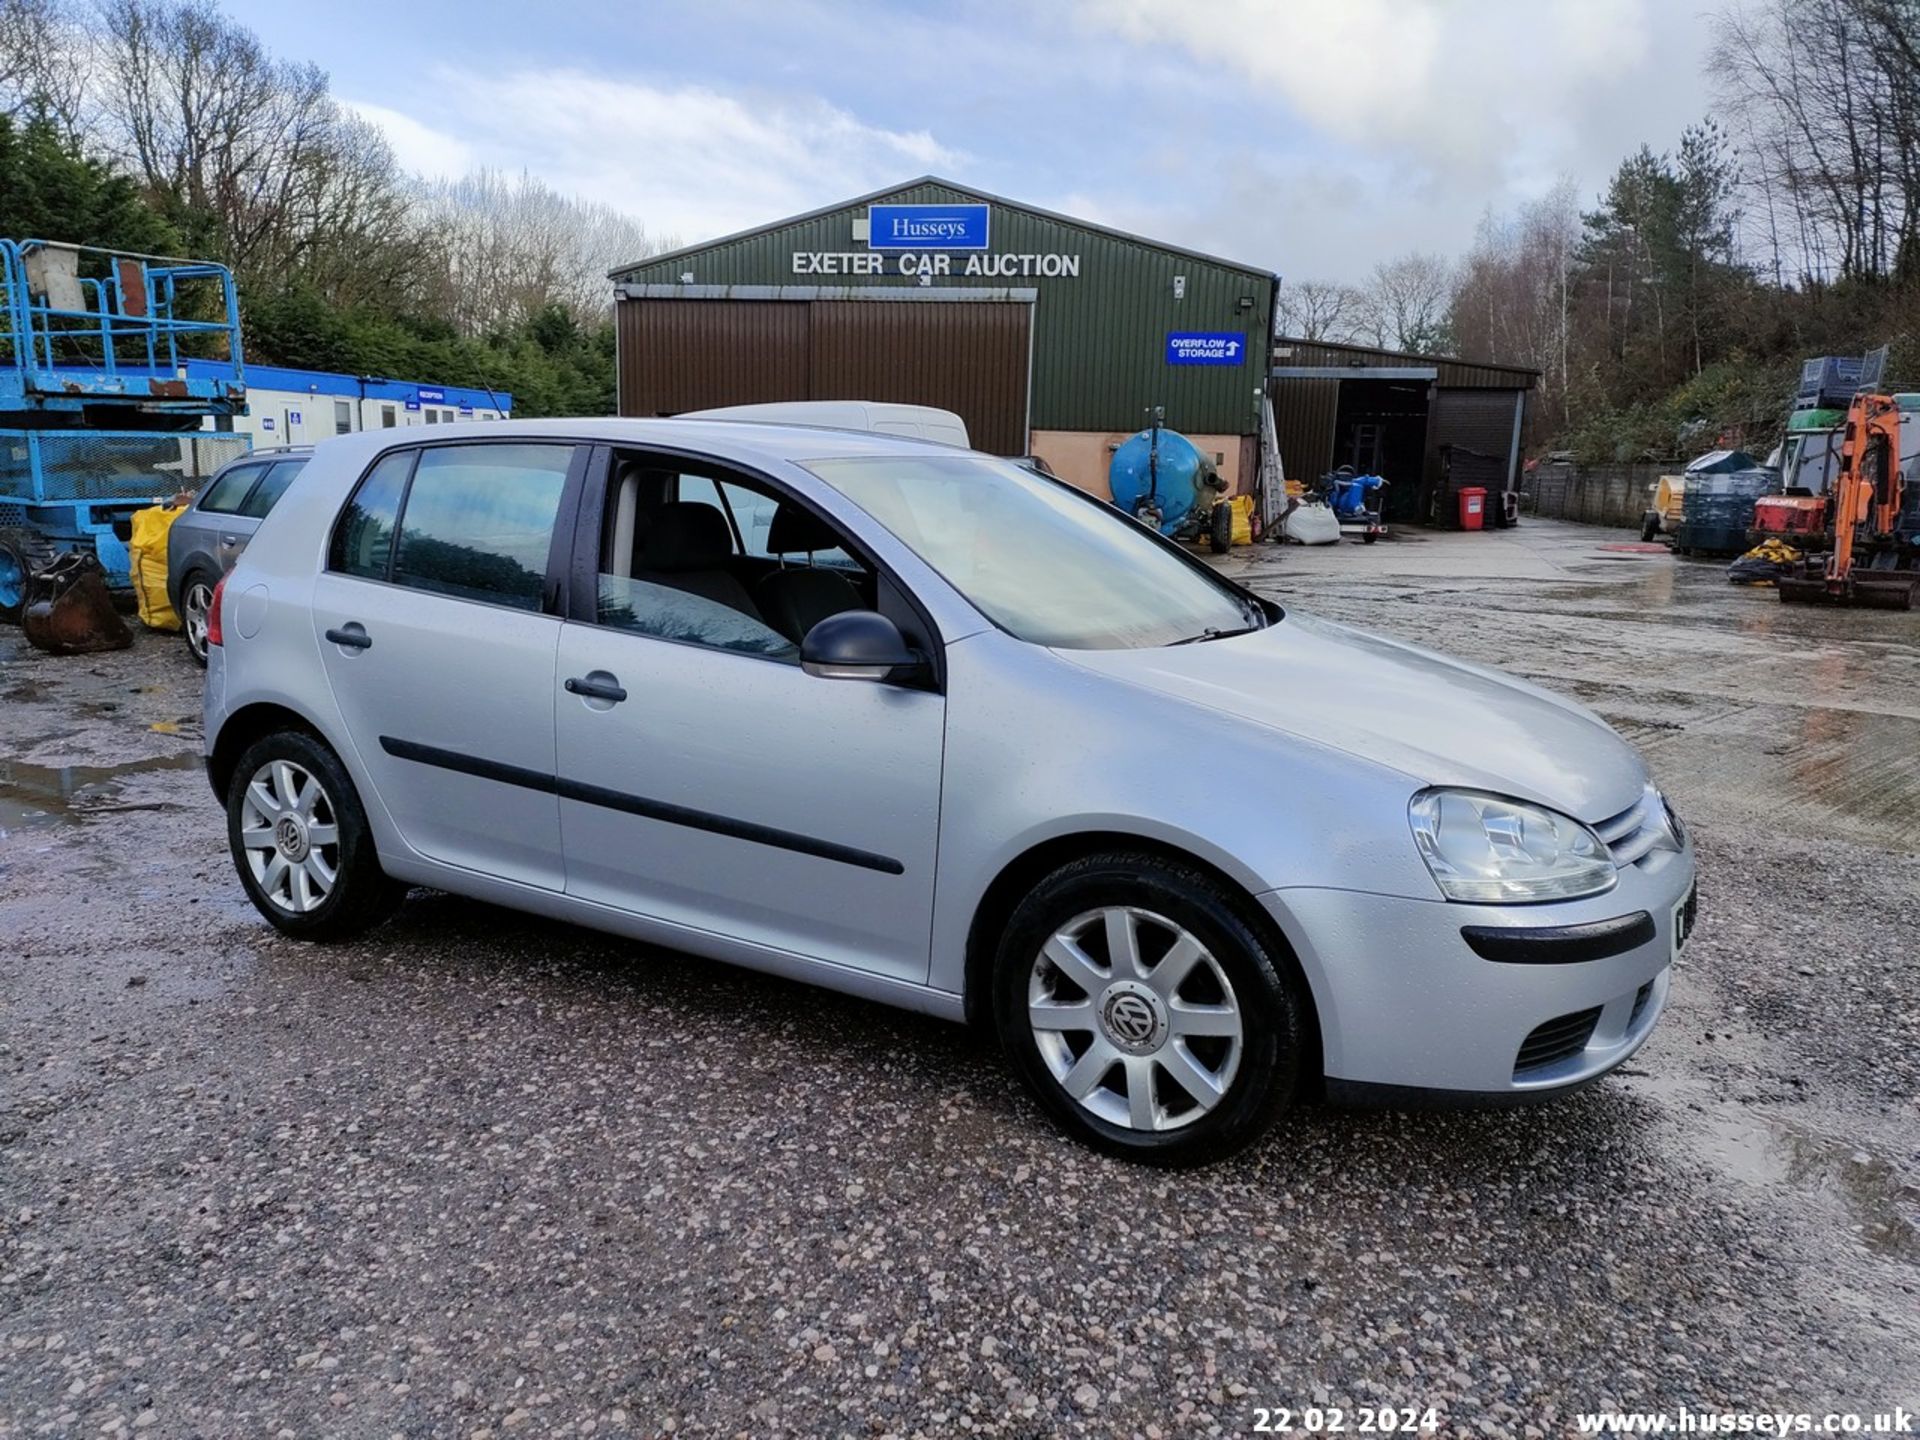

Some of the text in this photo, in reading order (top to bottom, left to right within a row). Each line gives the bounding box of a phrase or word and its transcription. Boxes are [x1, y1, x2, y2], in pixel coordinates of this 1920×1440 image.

[892, 218, 966, 240] Husseys
[792, 252, 1080, 277] EXETER CAR AUCTION
[1171, 339, 1226, 348] OVERFLOW
[1178, 349, 1225, 358] STORAGE
